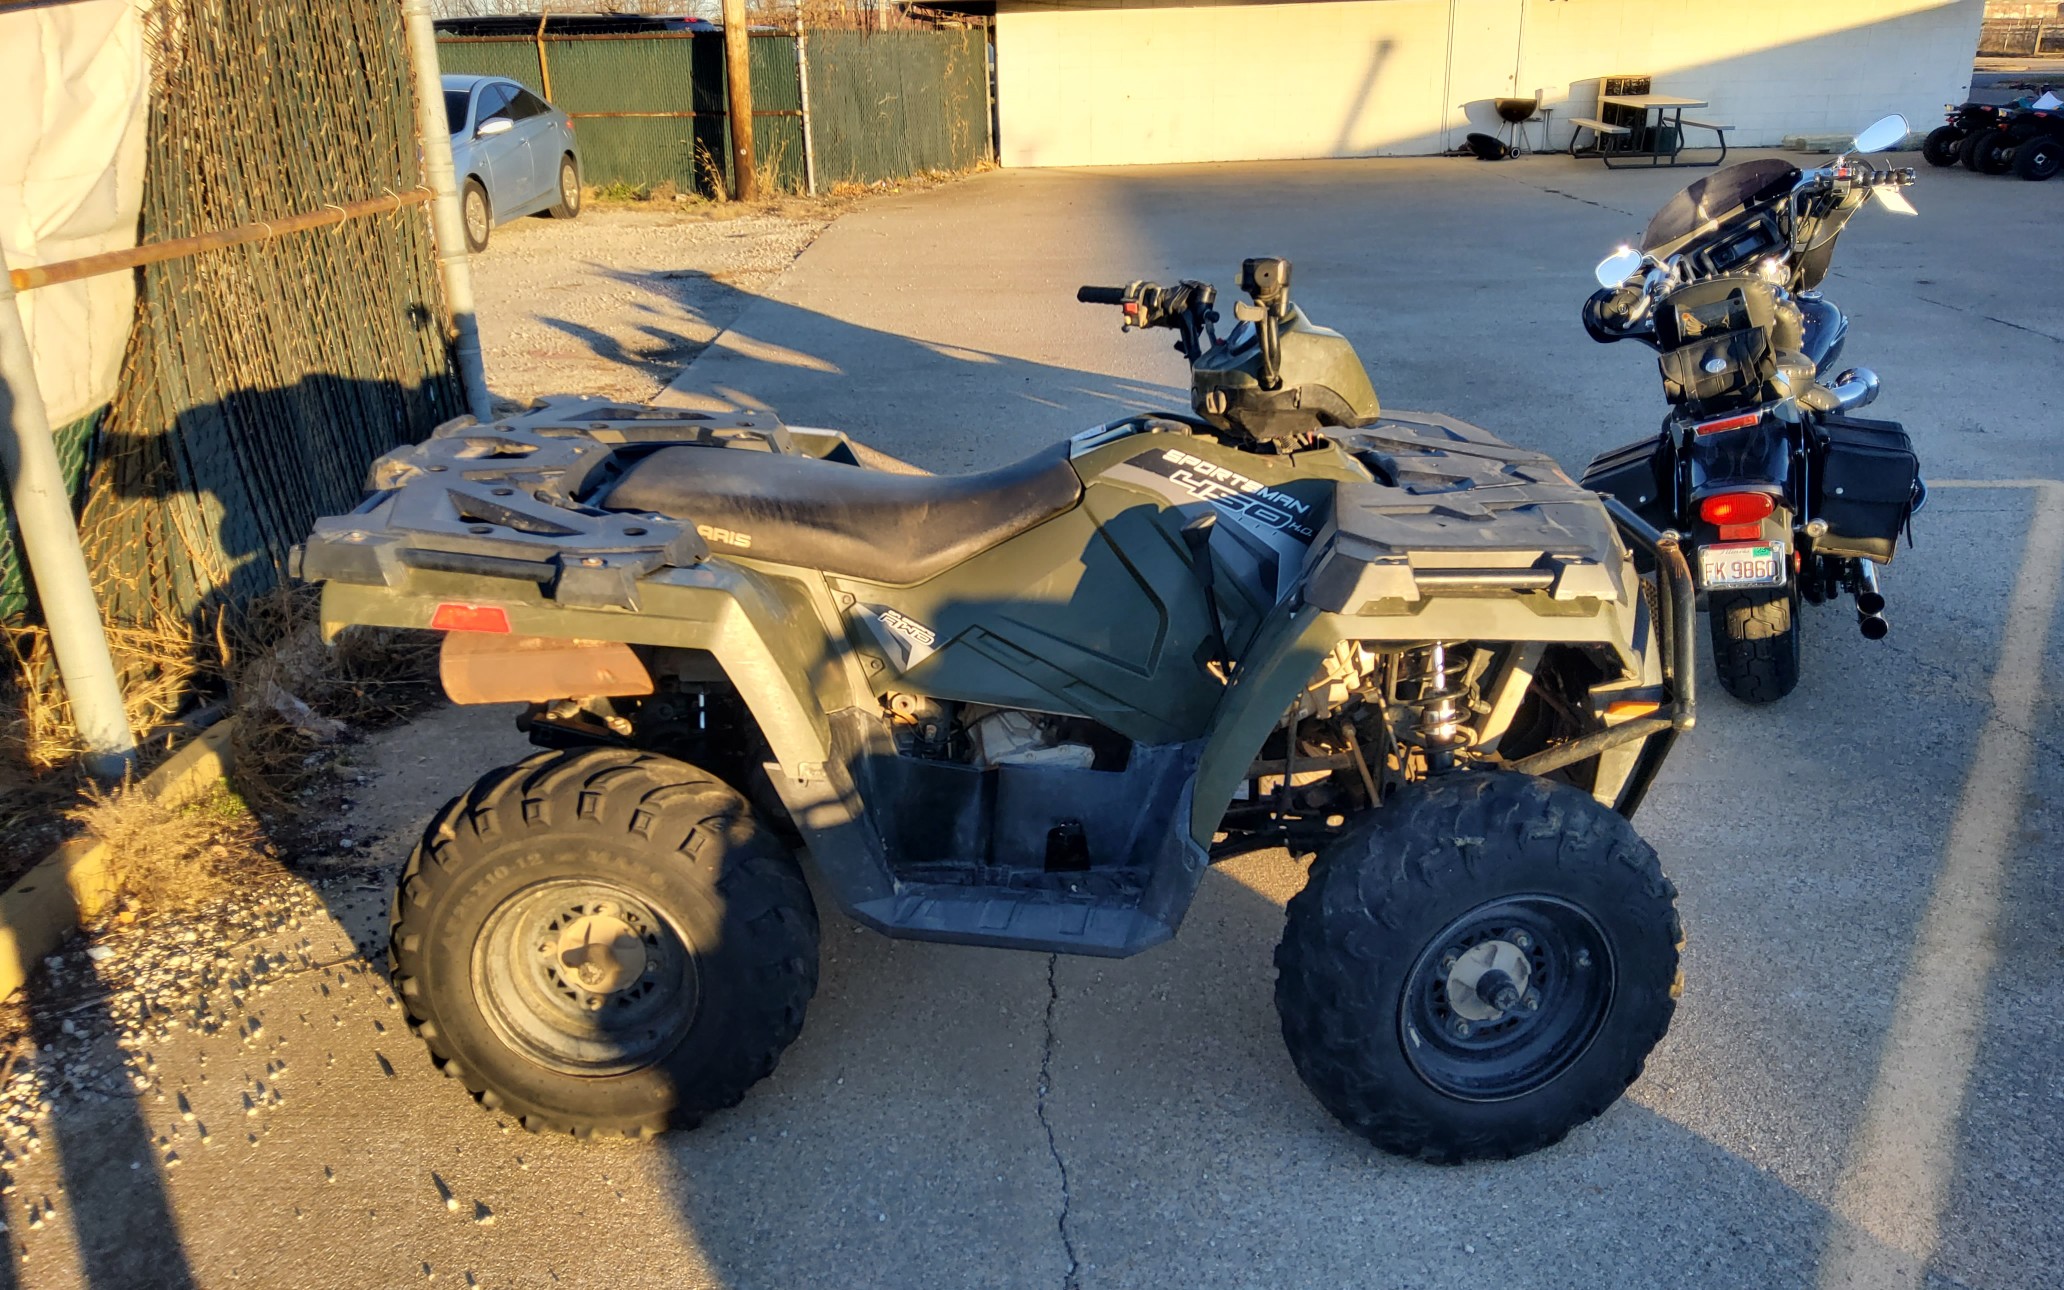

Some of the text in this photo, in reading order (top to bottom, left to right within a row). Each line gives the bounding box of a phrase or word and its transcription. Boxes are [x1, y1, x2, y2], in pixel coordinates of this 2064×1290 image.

[1162, 449, 1310, 514] SPORTSMAN
[1169, 470, 1293, 530] 450
[878, 612, 935, 646] AWD
